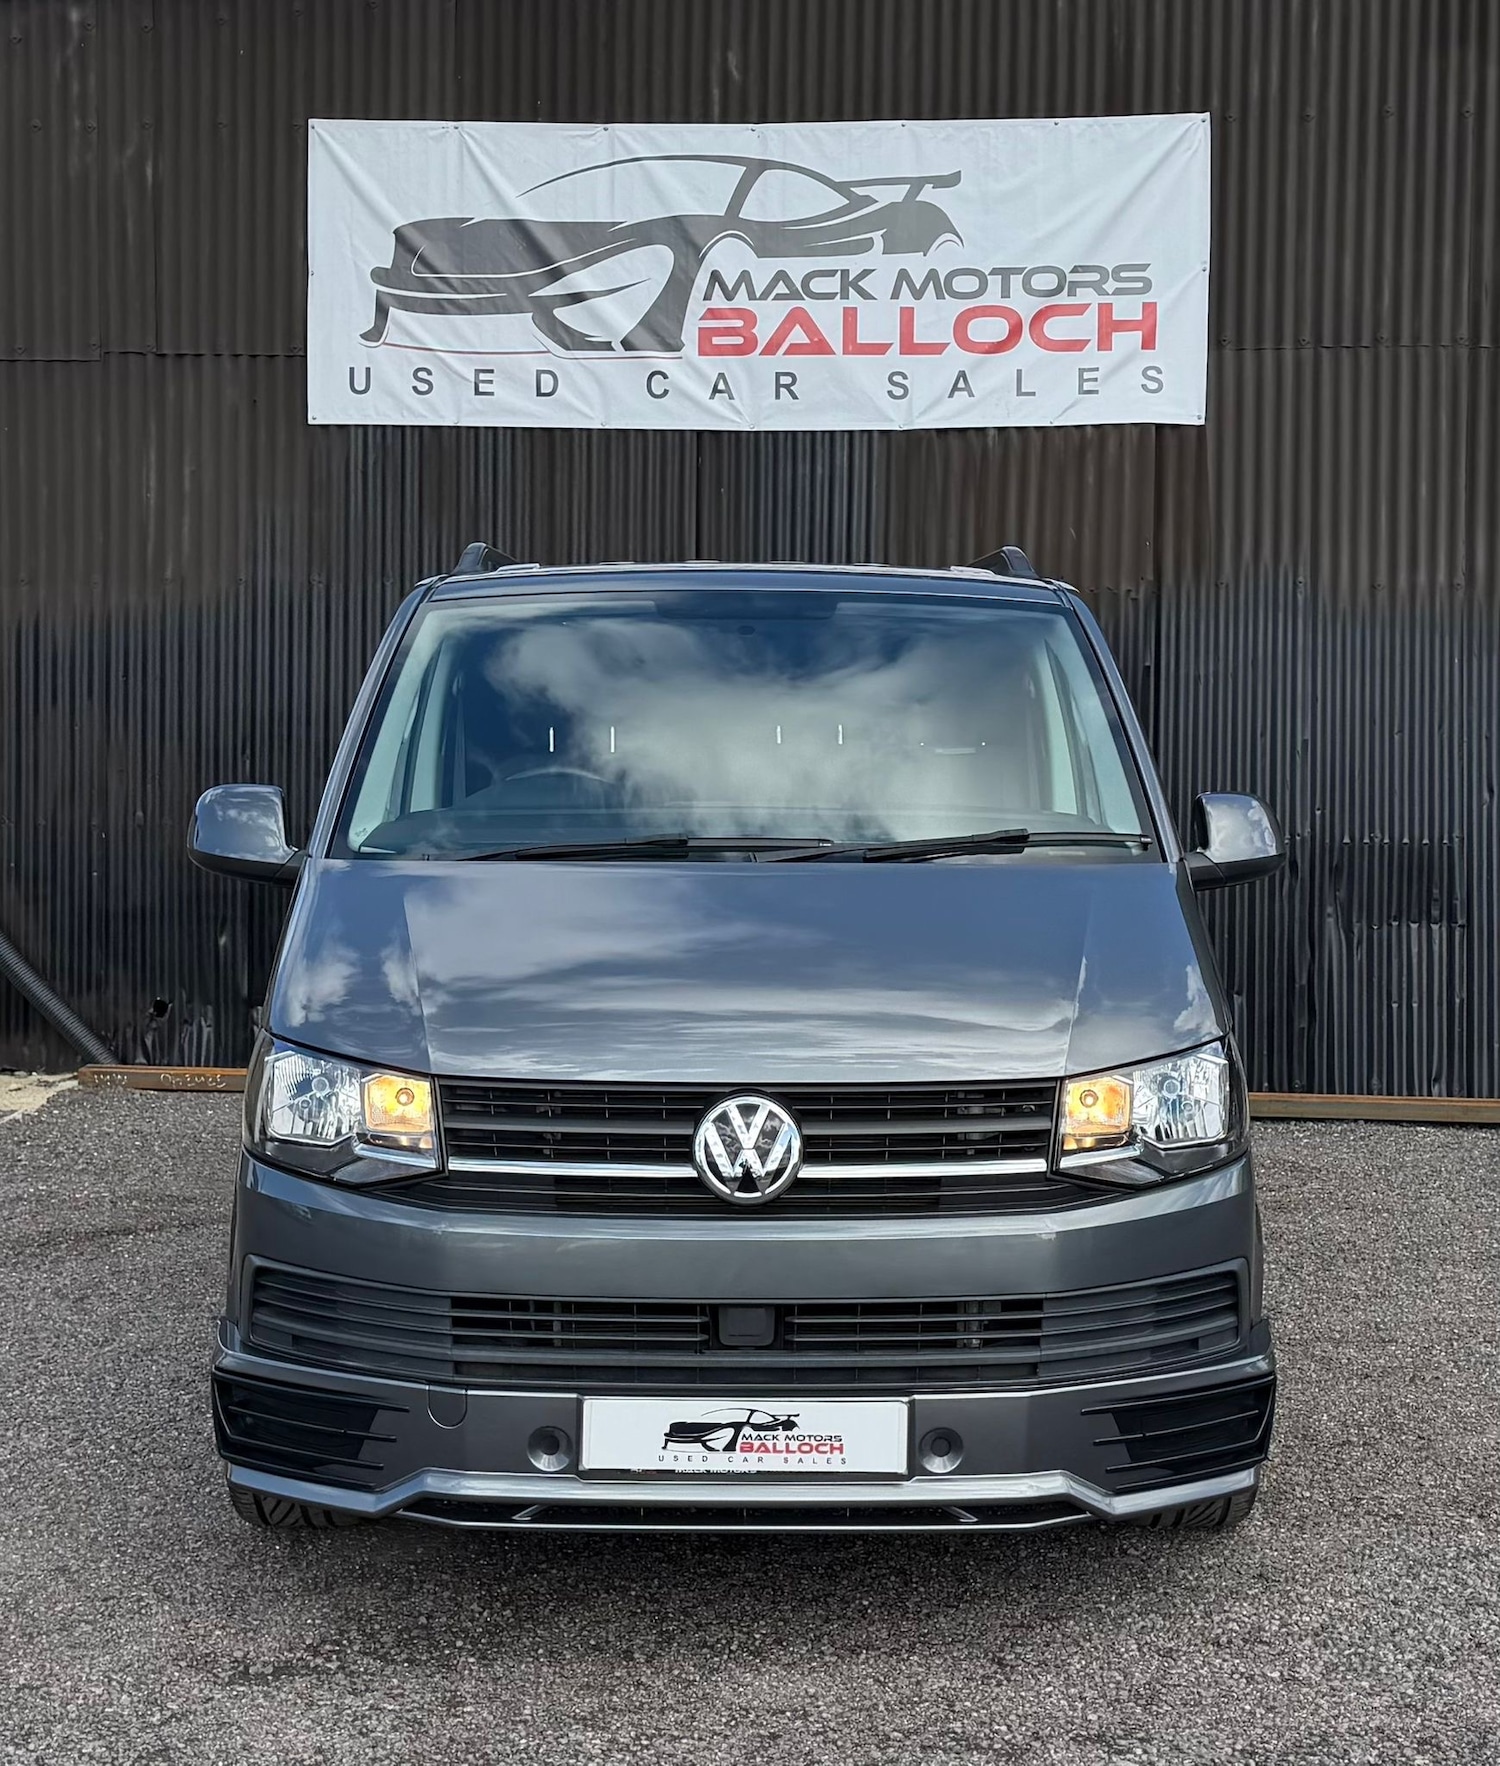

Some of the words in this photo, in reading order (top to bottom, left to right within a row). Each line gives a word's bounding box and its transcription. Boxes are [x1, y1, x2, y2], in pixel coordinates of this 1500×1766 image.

[703, 268, 878, 301] MACK
[890, 263, 1153, 301] MOTORS
[697, 301, 1158, 357] BALLOCH
[348, 366, 559, 398] USED
[645, 369, 800, 401] CAR
[886, 365, 1164, 400] SALES
[739, 1442, 844, 1455] BALLOCH
[741, 1433, 780, 1442] MACK
[784, 1434, 843, 1443] MOTORS
[658, 1455, 708, 1463] USED
[727, 1456, 764, 1464] CAR
[783, 1457, 847, 1465] SALES
